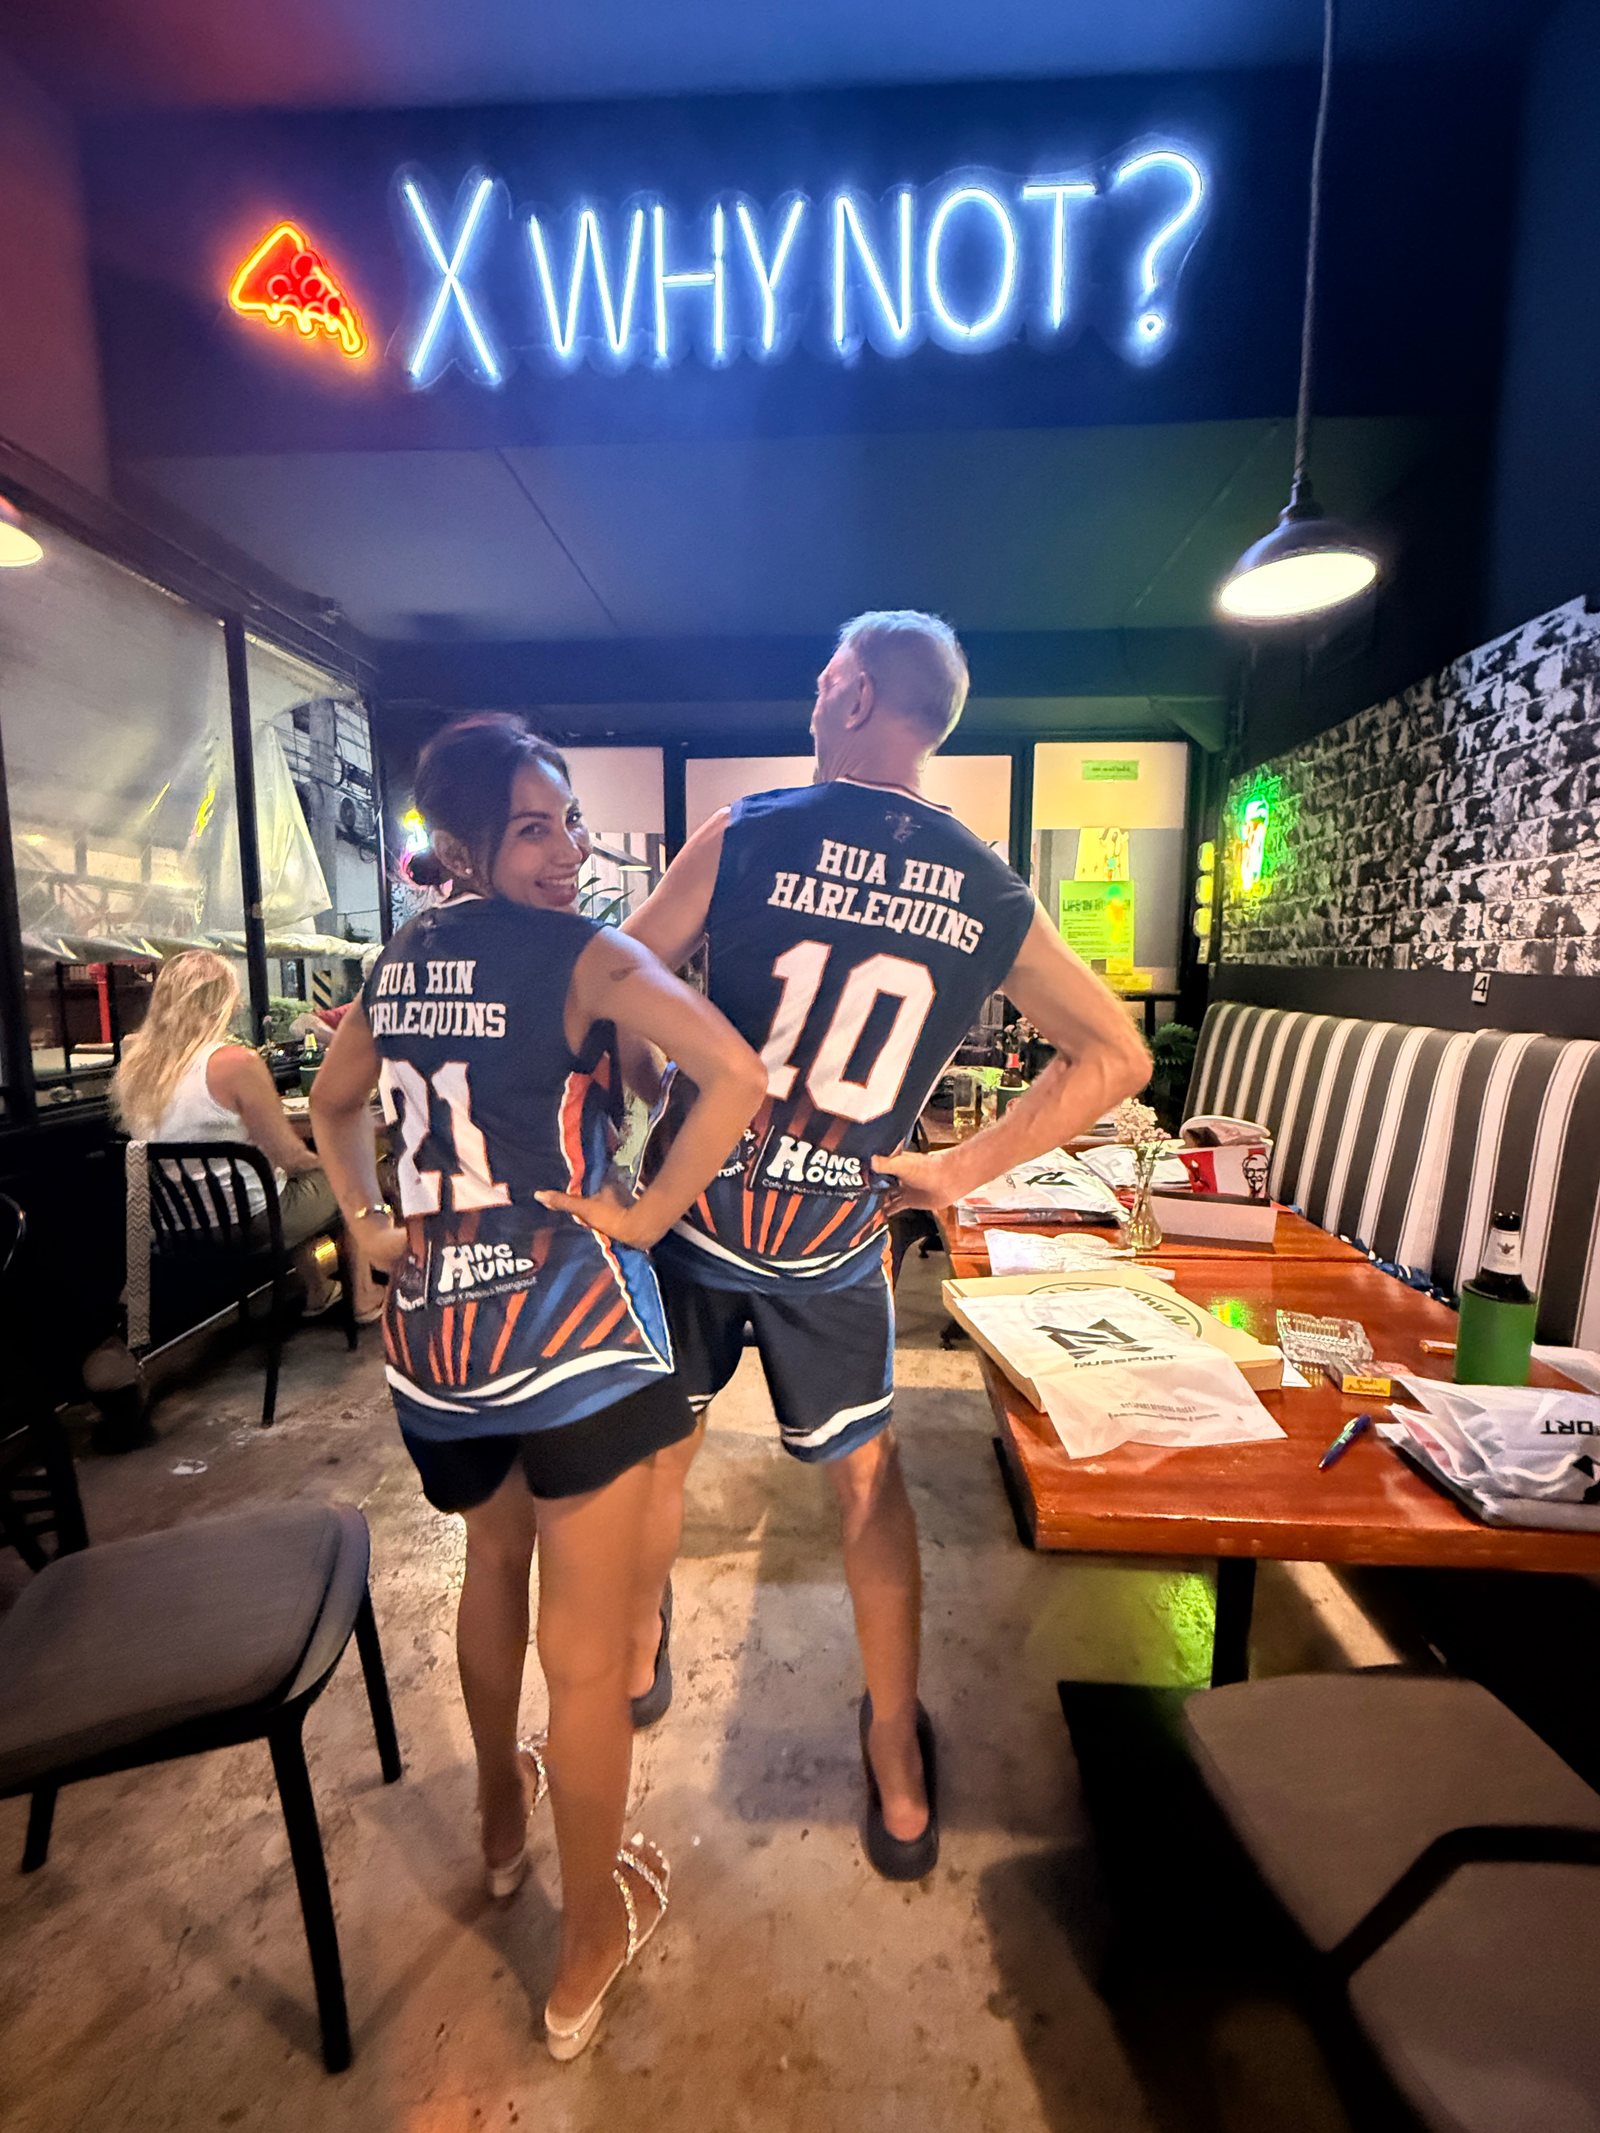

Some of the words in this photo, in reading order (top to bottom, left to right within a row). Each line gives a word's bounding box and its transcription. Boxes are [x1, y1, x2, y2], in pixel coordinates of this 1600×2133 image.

[402, 176, 500, 378] X
[527, 197, 806, 362] WHY
[816, 838, 887, 886] HUA
[900, 859, 965, 904] HIN
[767, 872, 984, 955] HARLEQUINS
[376, 962, 416, 997] HUA
[425, 960, 476, 995] HIN
[1474, 976, 1488, 997] 4
[759, 939, 937, 1124] 10
[378, 1057, 513, 1218] 21
[1540, 1418, 1600, 1438] ORT
